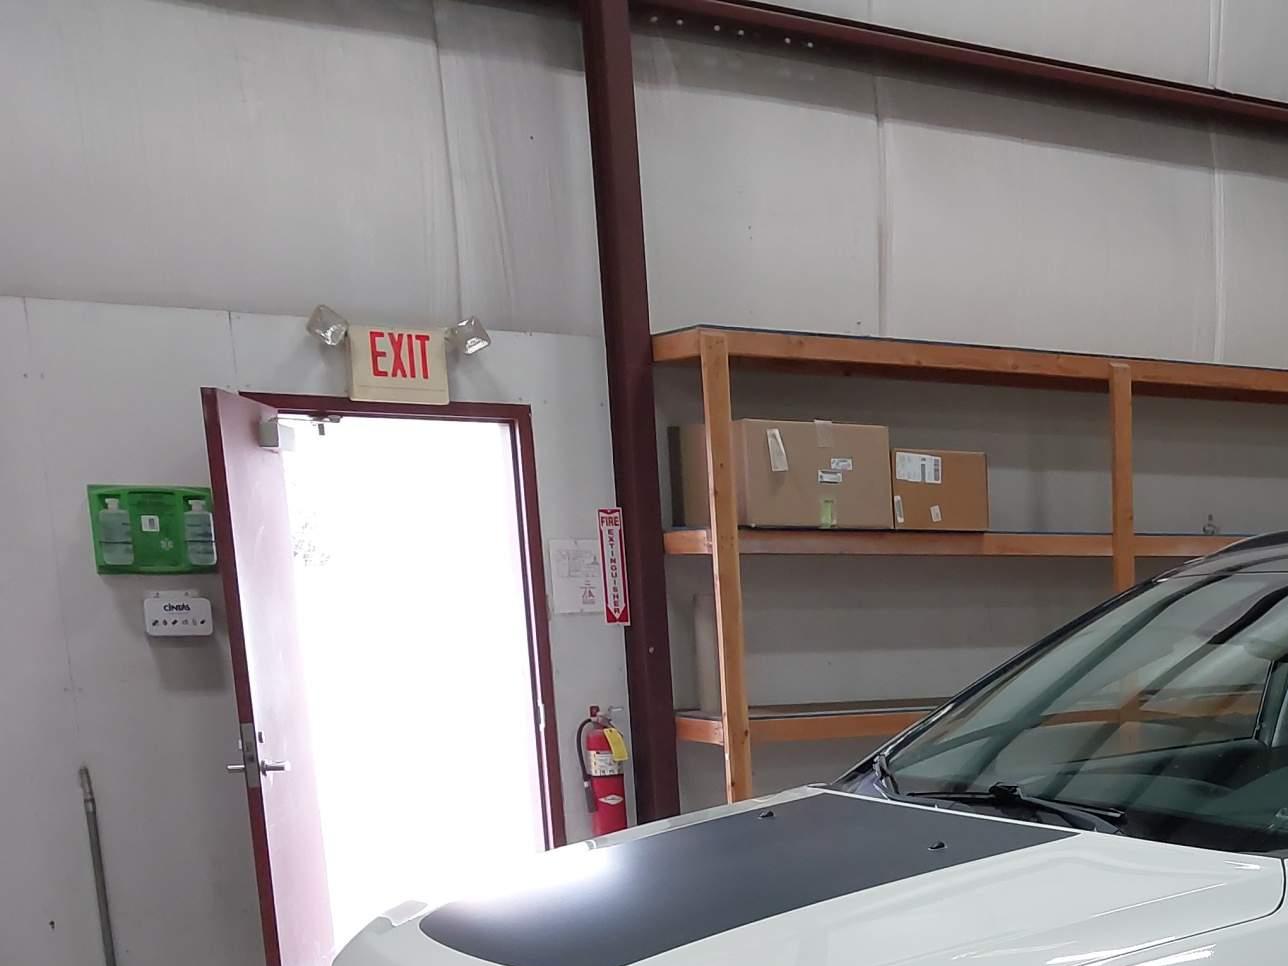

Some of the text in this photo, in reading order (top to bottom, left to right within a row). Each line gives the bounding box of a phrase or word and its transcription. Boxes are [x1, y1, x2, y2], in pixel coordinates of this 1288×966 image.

[369, 330, 430, 380] EXIT
[600, 516, 620, 527] FIRE
[607, 529, 621, 614] EXTINGUISHER
